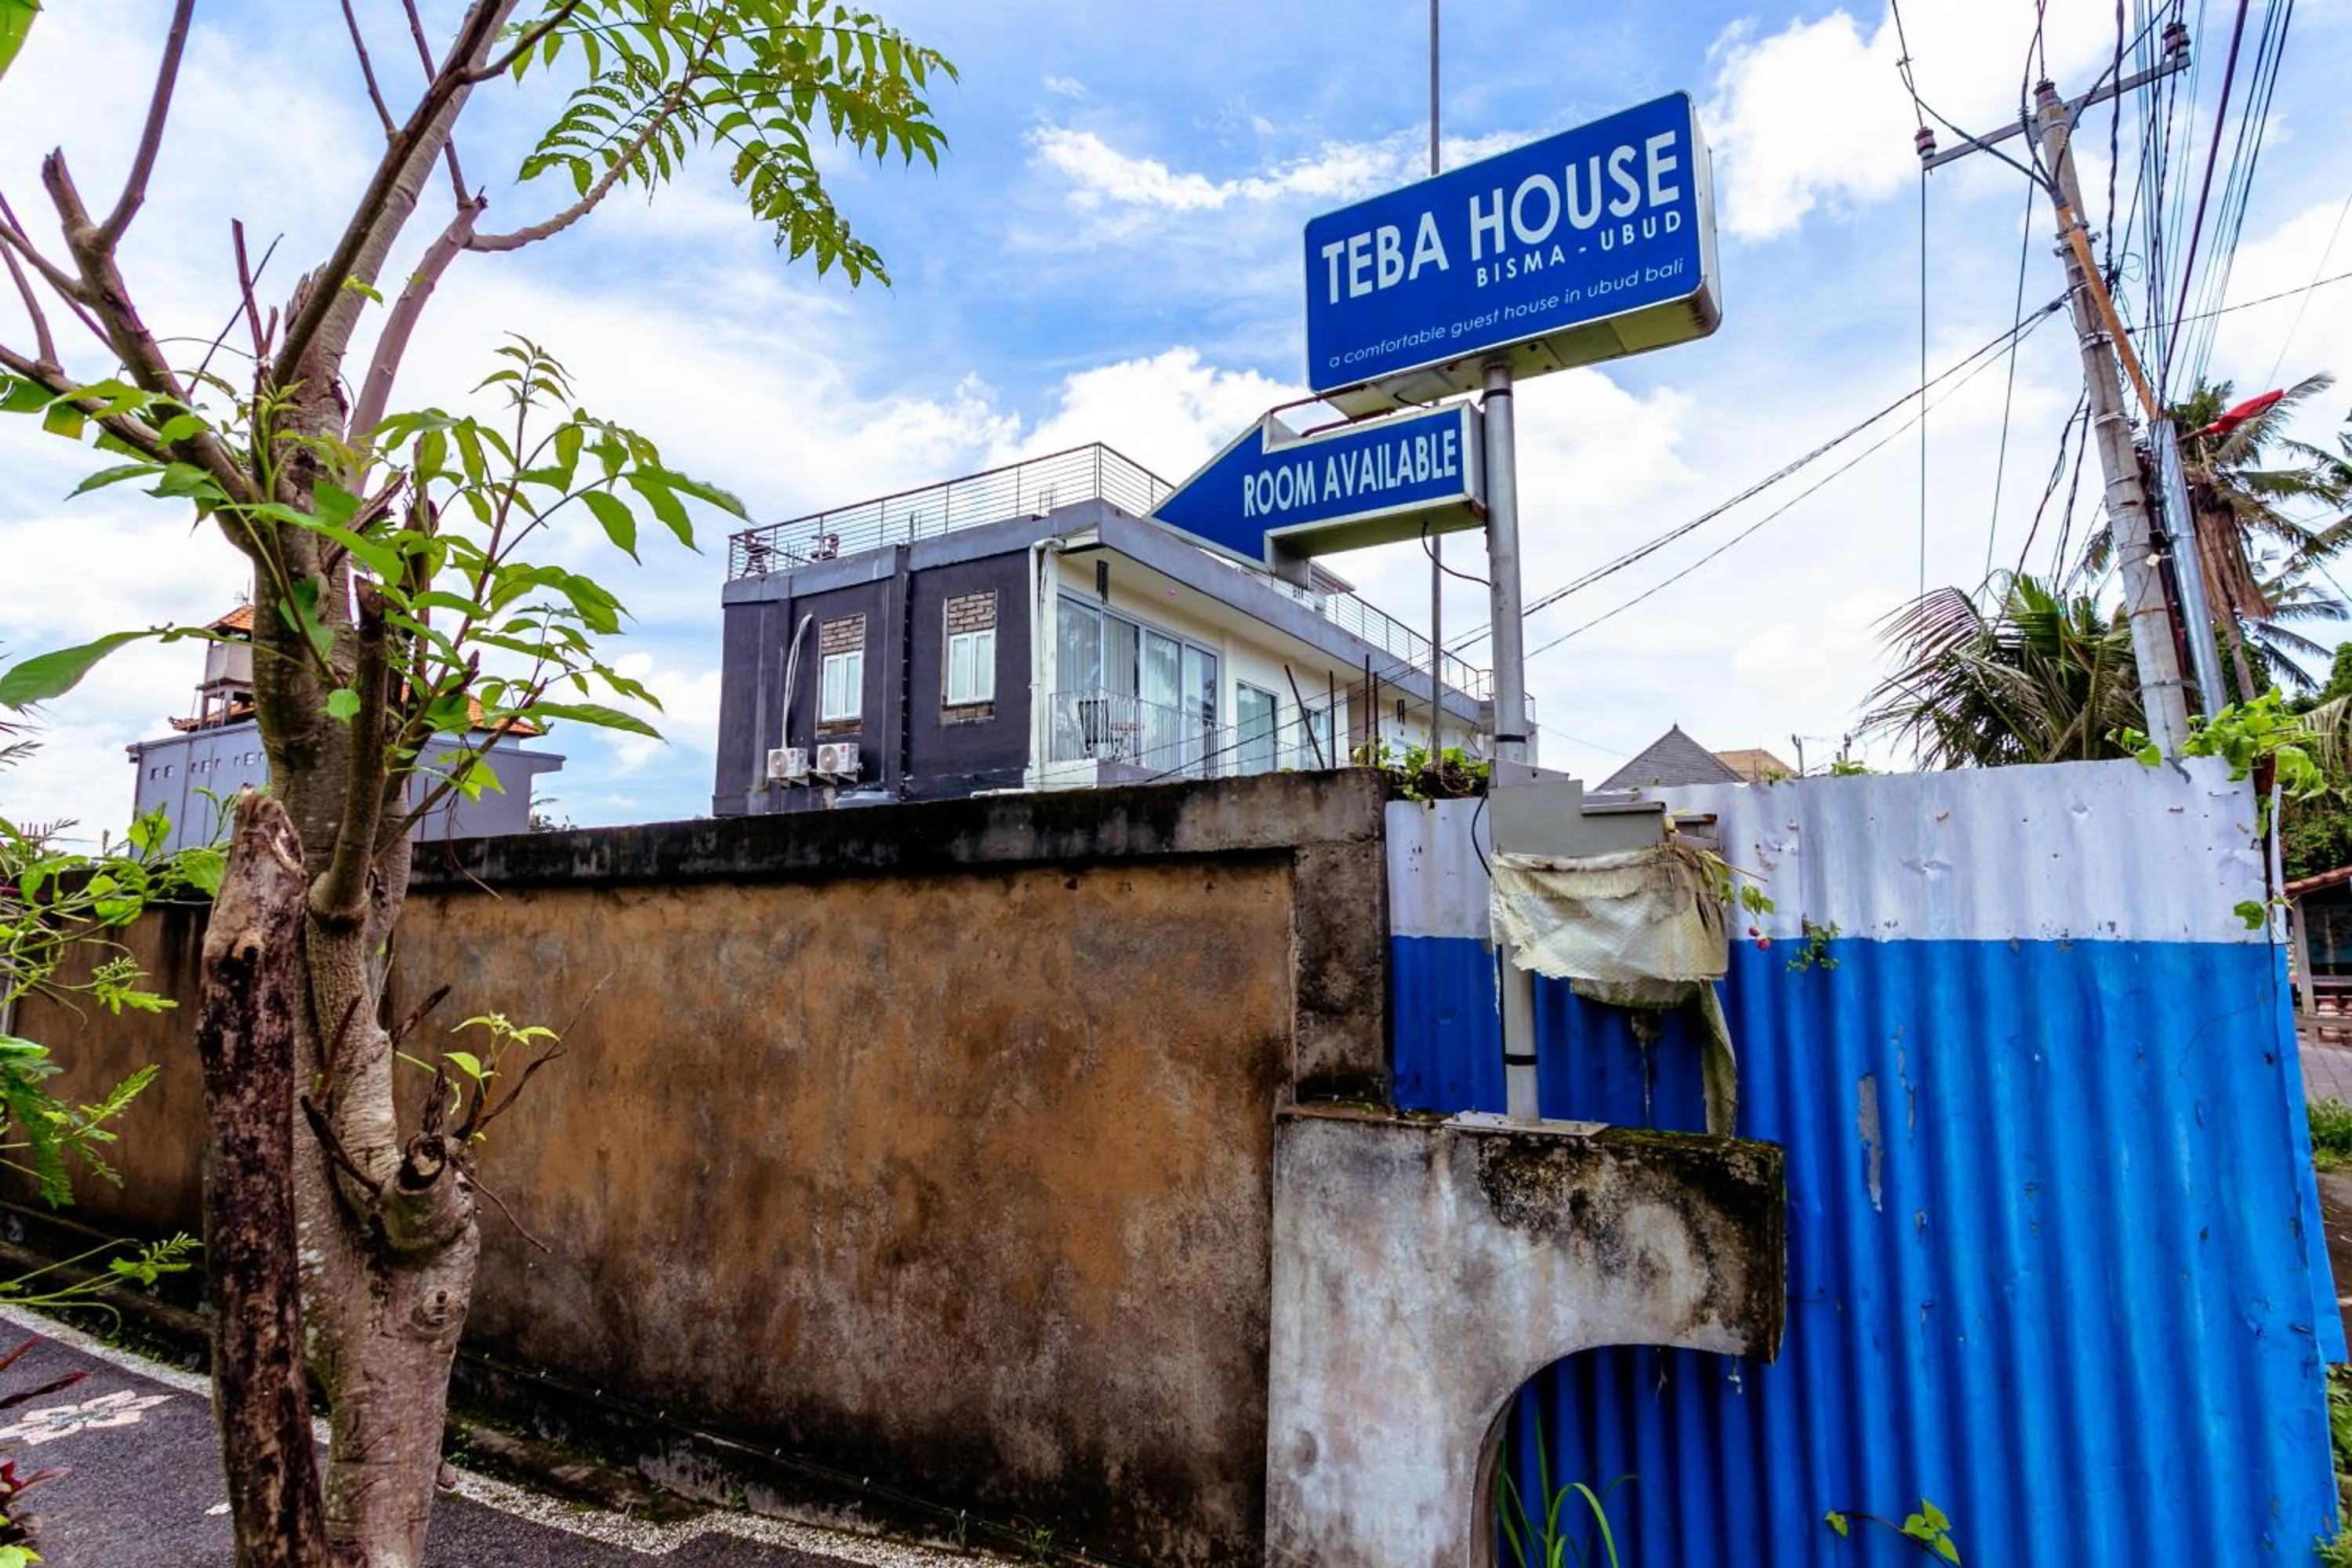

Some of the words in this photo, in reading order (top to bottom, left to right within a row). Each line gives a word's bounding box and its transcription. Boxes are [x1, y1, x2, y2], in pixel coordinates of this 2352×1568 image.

[1322, 211, 1450, 304] TEBA
[1469, 130, 1680, 261] HOUSE
[1476, 244, 1566, 288] BISMA
[1600, 211, 1681, 251] UBUD
[1329, 354, 1340, 368] a
[1344, 325, 1446, 365] comfortable
[1450, 309, 1499, 339] guest
[1504, 295, 1559, 318] house
[1564, 287, 1581, 305] in
[1587, 270, 1639, 299] ubud
[1645, 257, 1683, 282] bali
[1243, 460, 1316, 518] ROOM
[1323, 429, 1457, 502] AVAILABLE
